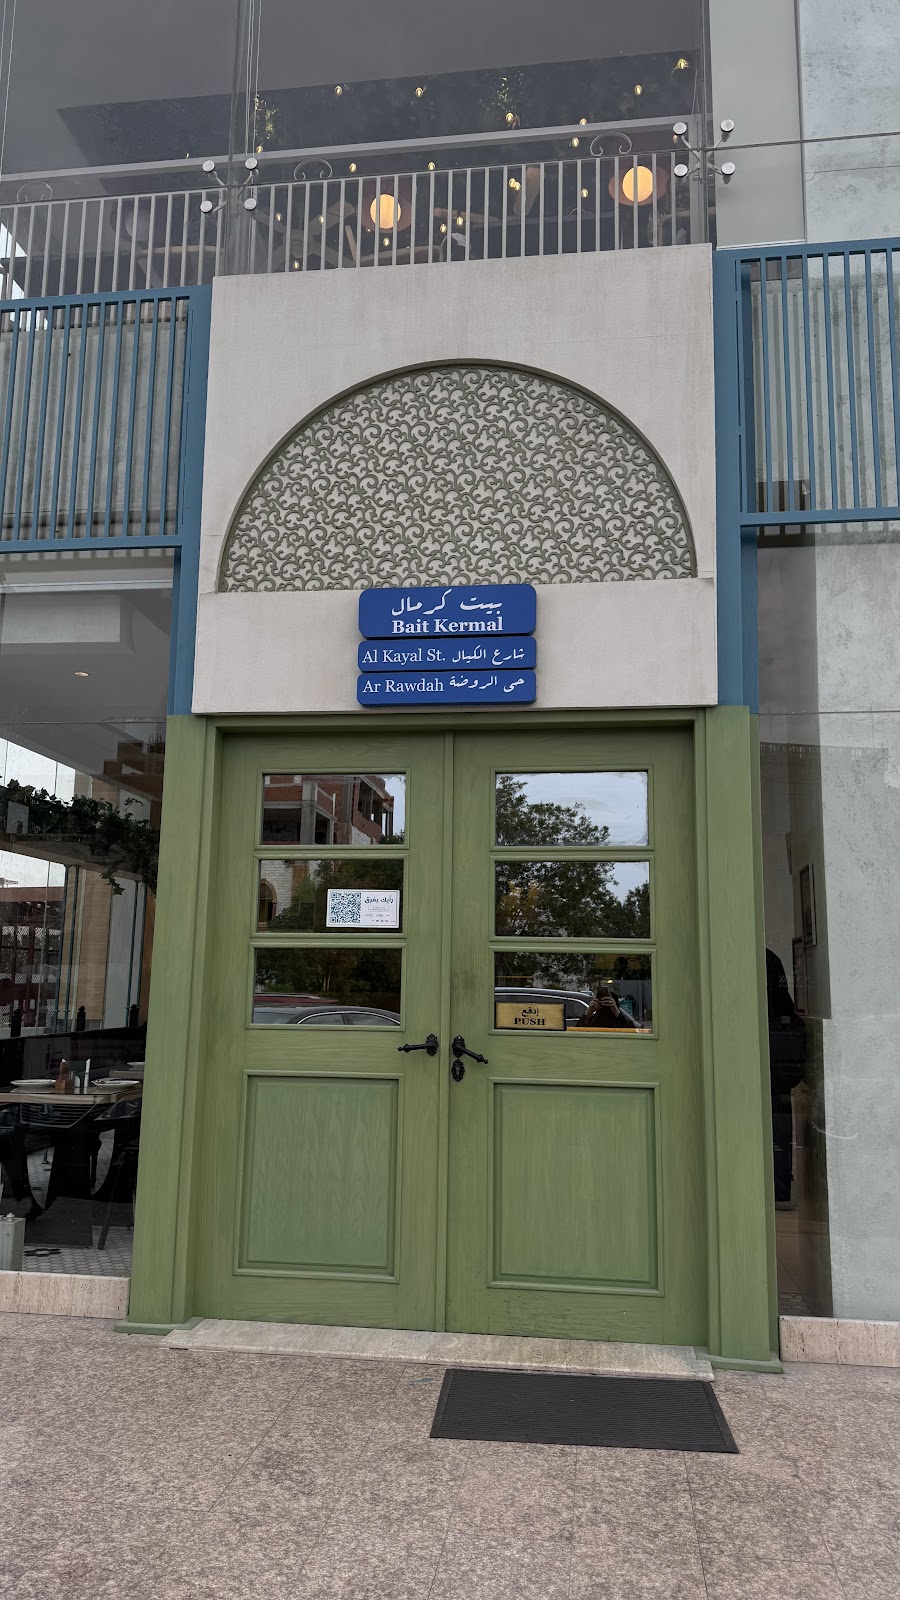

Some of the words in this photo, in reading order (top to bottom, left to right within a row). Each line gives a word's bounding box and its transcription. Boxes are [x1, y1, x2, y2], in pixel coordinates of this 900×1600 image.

[391, 588, 452, 617] كرمال
[459, 596, 503, 615] بيت
[391, 618, 429, 634] Bait
[434, 616, 503, 633] Kermal
[362, 649, 378, 663] Al
[382, 648, 423, 666] Kayal
[426, 648, 446, 662] St.
[452, 645, 487, 664] الكيال
[491, 647, 525, 666] شارع
[362, 679, 381, 693] Ar
[385, 678, 444, 693] Rawdah
[449, 675, 498, 690] الروضة
[514, 1017, 546, 1026] PUSH
